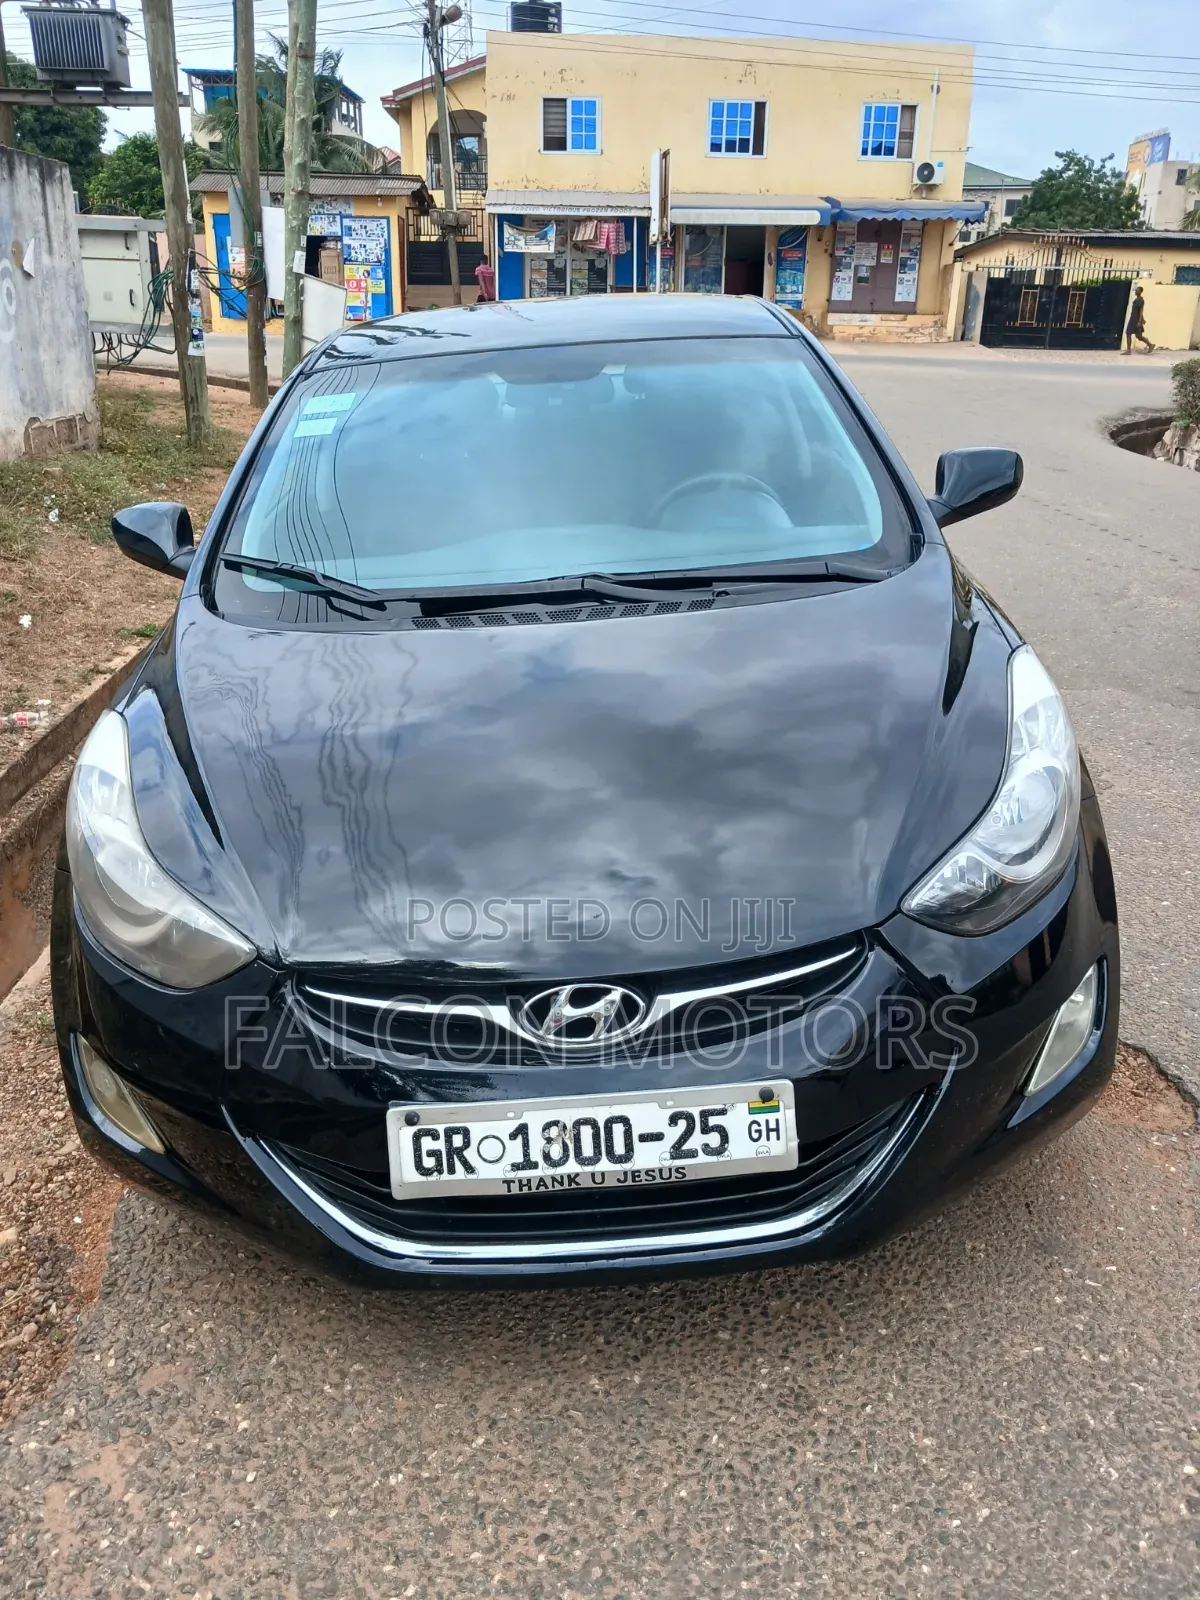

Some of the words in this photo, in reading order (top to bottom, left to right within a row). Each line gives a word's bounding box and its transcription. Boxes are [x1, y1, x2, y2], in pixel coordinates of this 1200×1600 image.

[412, 1125, 476, 1177] GR
[508, 1107, 730, 1171] 1800-25
[747, 1118, 781, 1143] GH
[502, 1172, 582, 1194] THANK
[590, 1172, 606, 1185] U
[617, 1166, 687, 1184] JESUS
